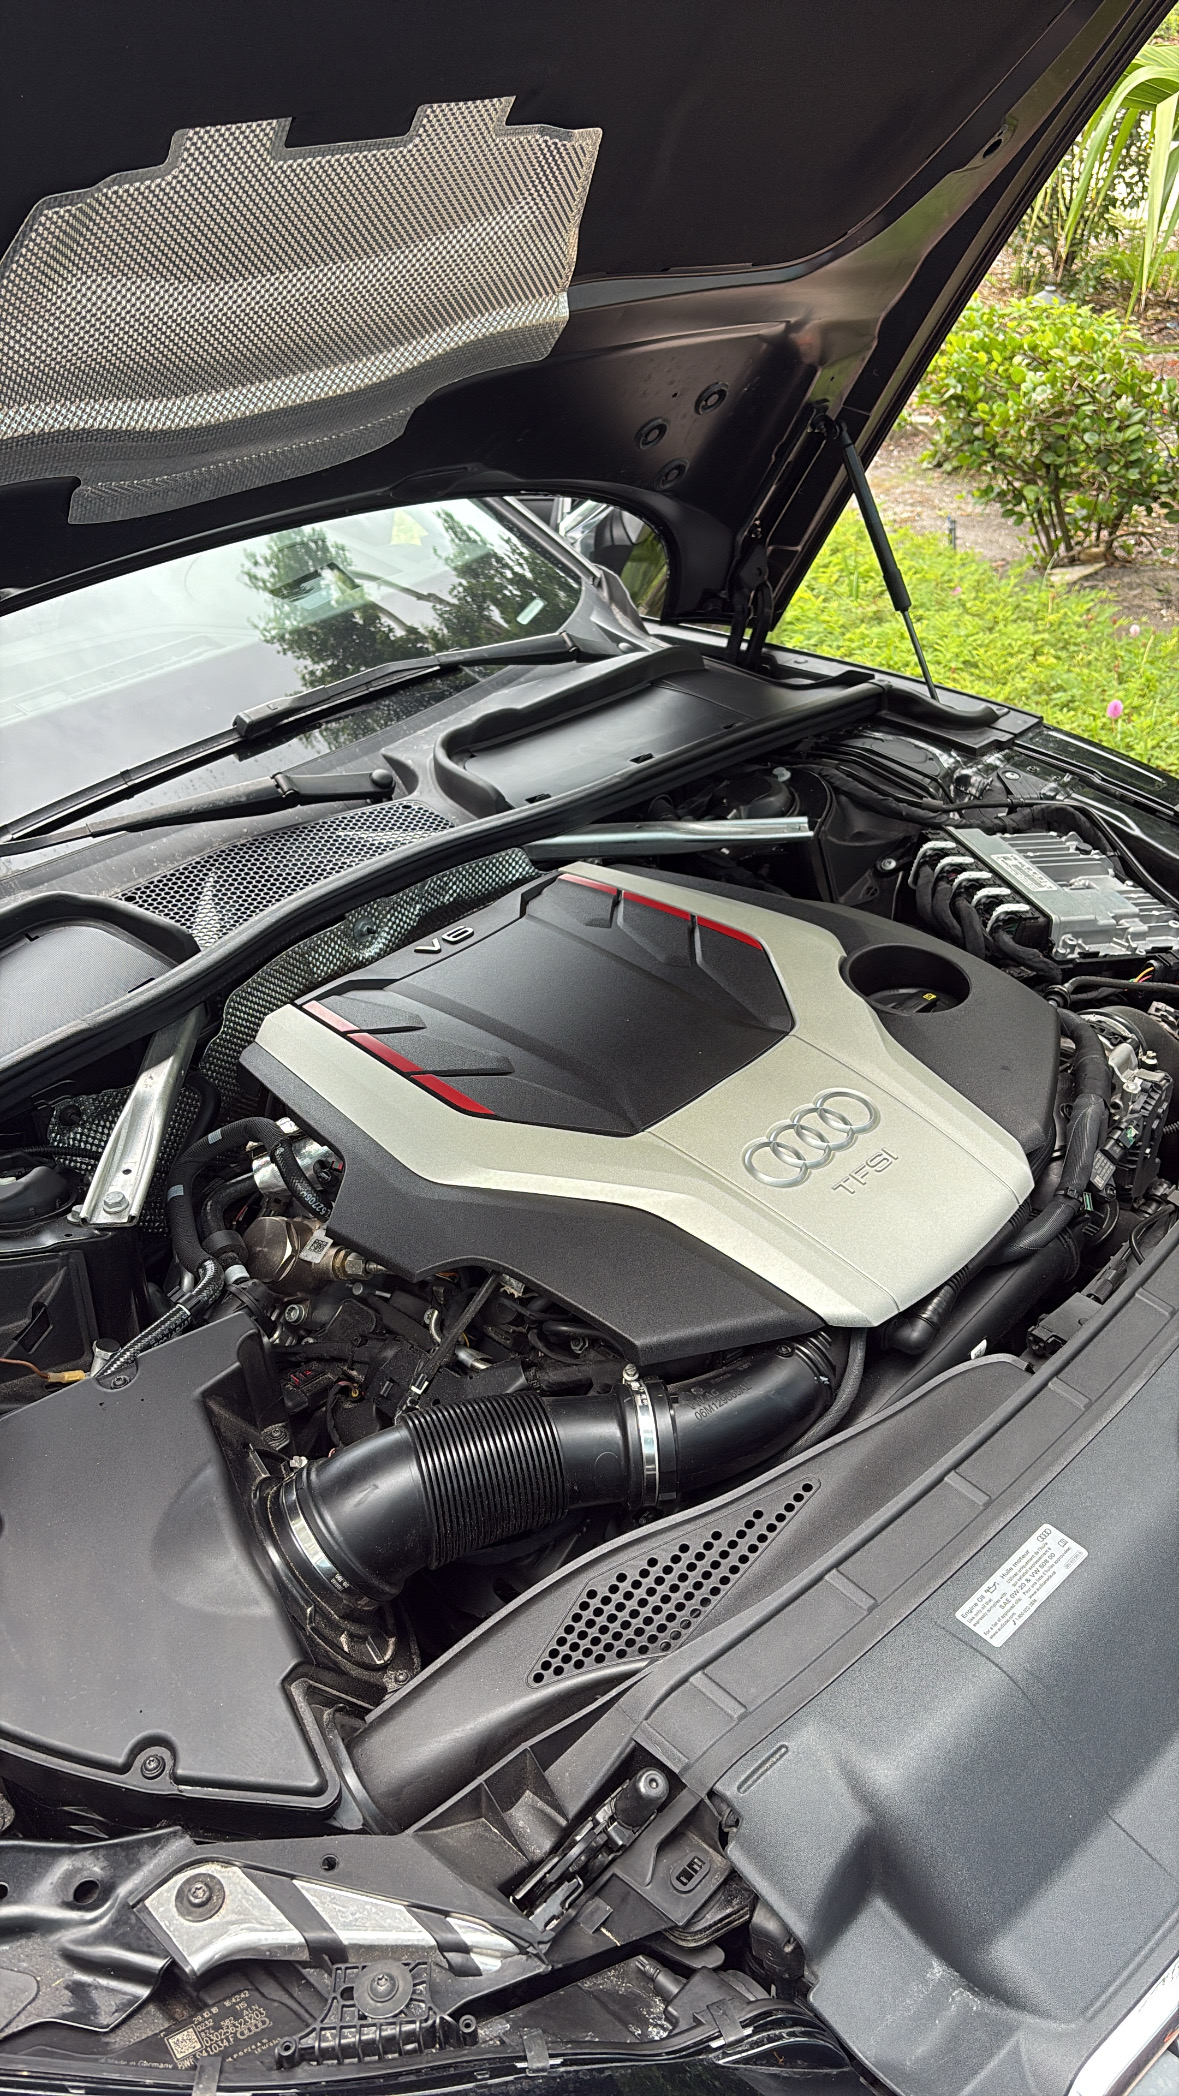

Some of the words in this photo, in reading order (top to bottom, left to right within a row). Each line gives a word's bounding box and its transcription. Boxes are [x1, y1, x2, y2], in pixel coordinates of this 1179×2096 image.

[414, 926, 474, 953] V6
[831, 1147, 898, 1194] TFSI
[999, 1566, 1013, 1579] Huile
[1011, 1549, 1030, 1567] moteur
[998, 1597, 1011, 1609] SAE
[1028, 1567, 1040, 1578] VW
[1047, 1551, 1056, 1560] 00
[960, 1601, 979, 1619] Engine
[976, 1594, 985, 1602] Oil
[196, 2018, 214, 2031] 0232
[202, 2007, 266, 2046] 030256323203
